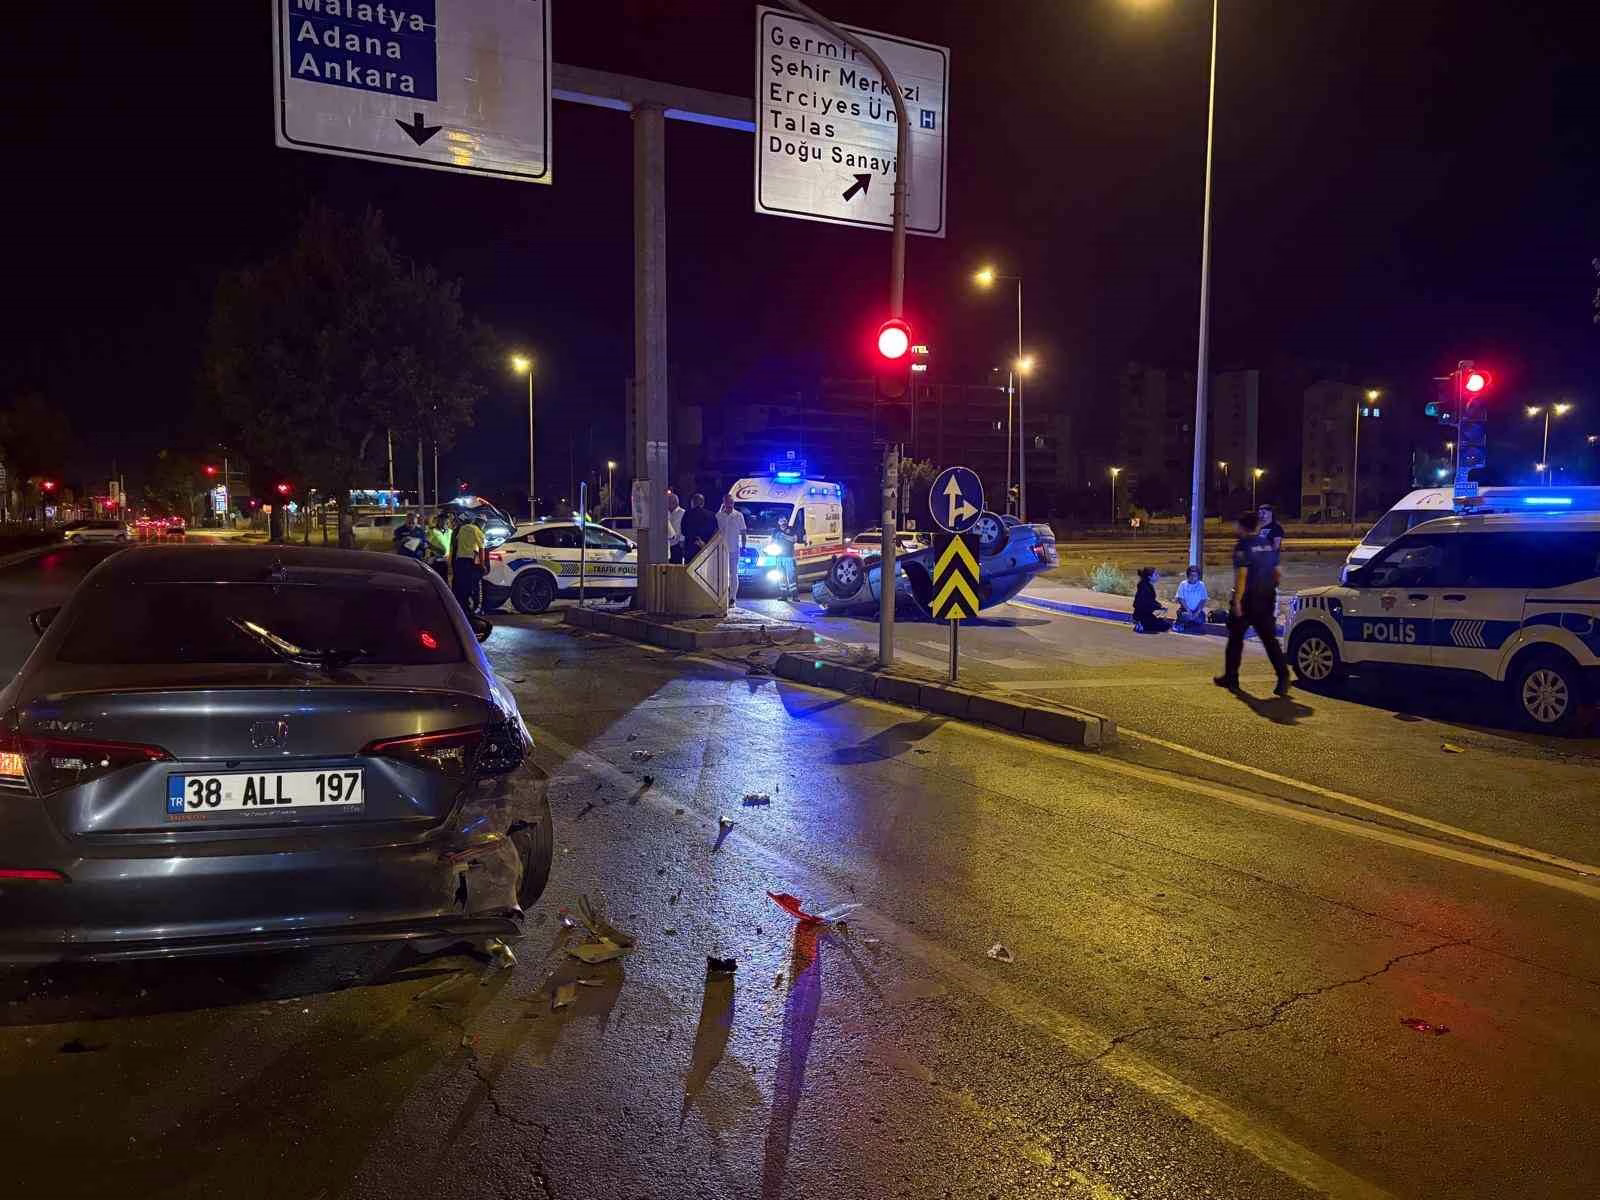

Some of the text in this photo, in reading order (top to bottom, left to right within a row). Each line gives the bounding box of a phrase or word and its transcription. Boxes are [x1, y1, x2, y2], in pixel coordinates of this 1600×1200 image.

[297, 20, 401, 59] Adana
[770, 26, 865, 61] Germir
[298, 52, 415, 93] Ankara
[770, 54, 920, 102] Şehir Merkzi
[770, 82, 860, 115] Erciyes
[869, 96, 912, 126] Ün.
[770, 109, 834, 137] Talas
[769, 136, 897, 175] Doğu Sanayi
[1363, 618, 1416, 642] POLİS
[169, 797, 183, 807] TR
[187, 773, 360, 808] 38 ALL 197
